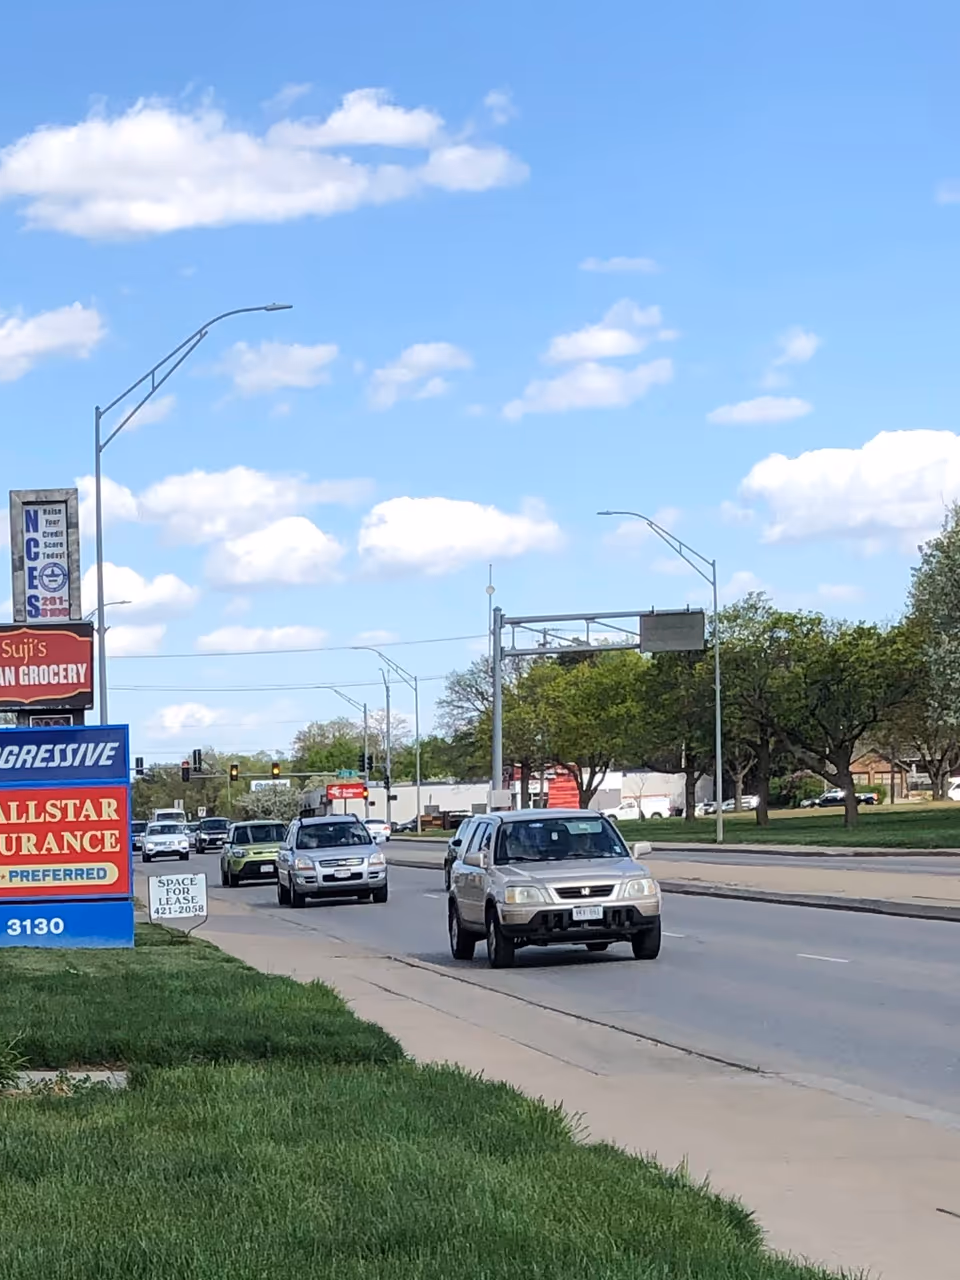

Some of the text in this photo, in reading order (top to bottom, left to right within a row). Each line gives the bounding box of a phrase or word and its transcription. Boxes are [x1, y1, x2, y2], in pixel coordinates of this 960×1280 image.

[42, 530, 63, 538] Credit
[43, 541, 64, 549] Score
[1, 638, 47, 664] Suji's
[19, 663, 87, 686] GROCERY
[8, 867, 108, 883] PREFERRED
[157, 877, 198, 888] SPACE
[166, 887, 190, 896] FOR
[159, 896, 198, 906] LEASE
[153, 904, 204, 915] 421-2058
[6, 917, 65, 936] 3130
